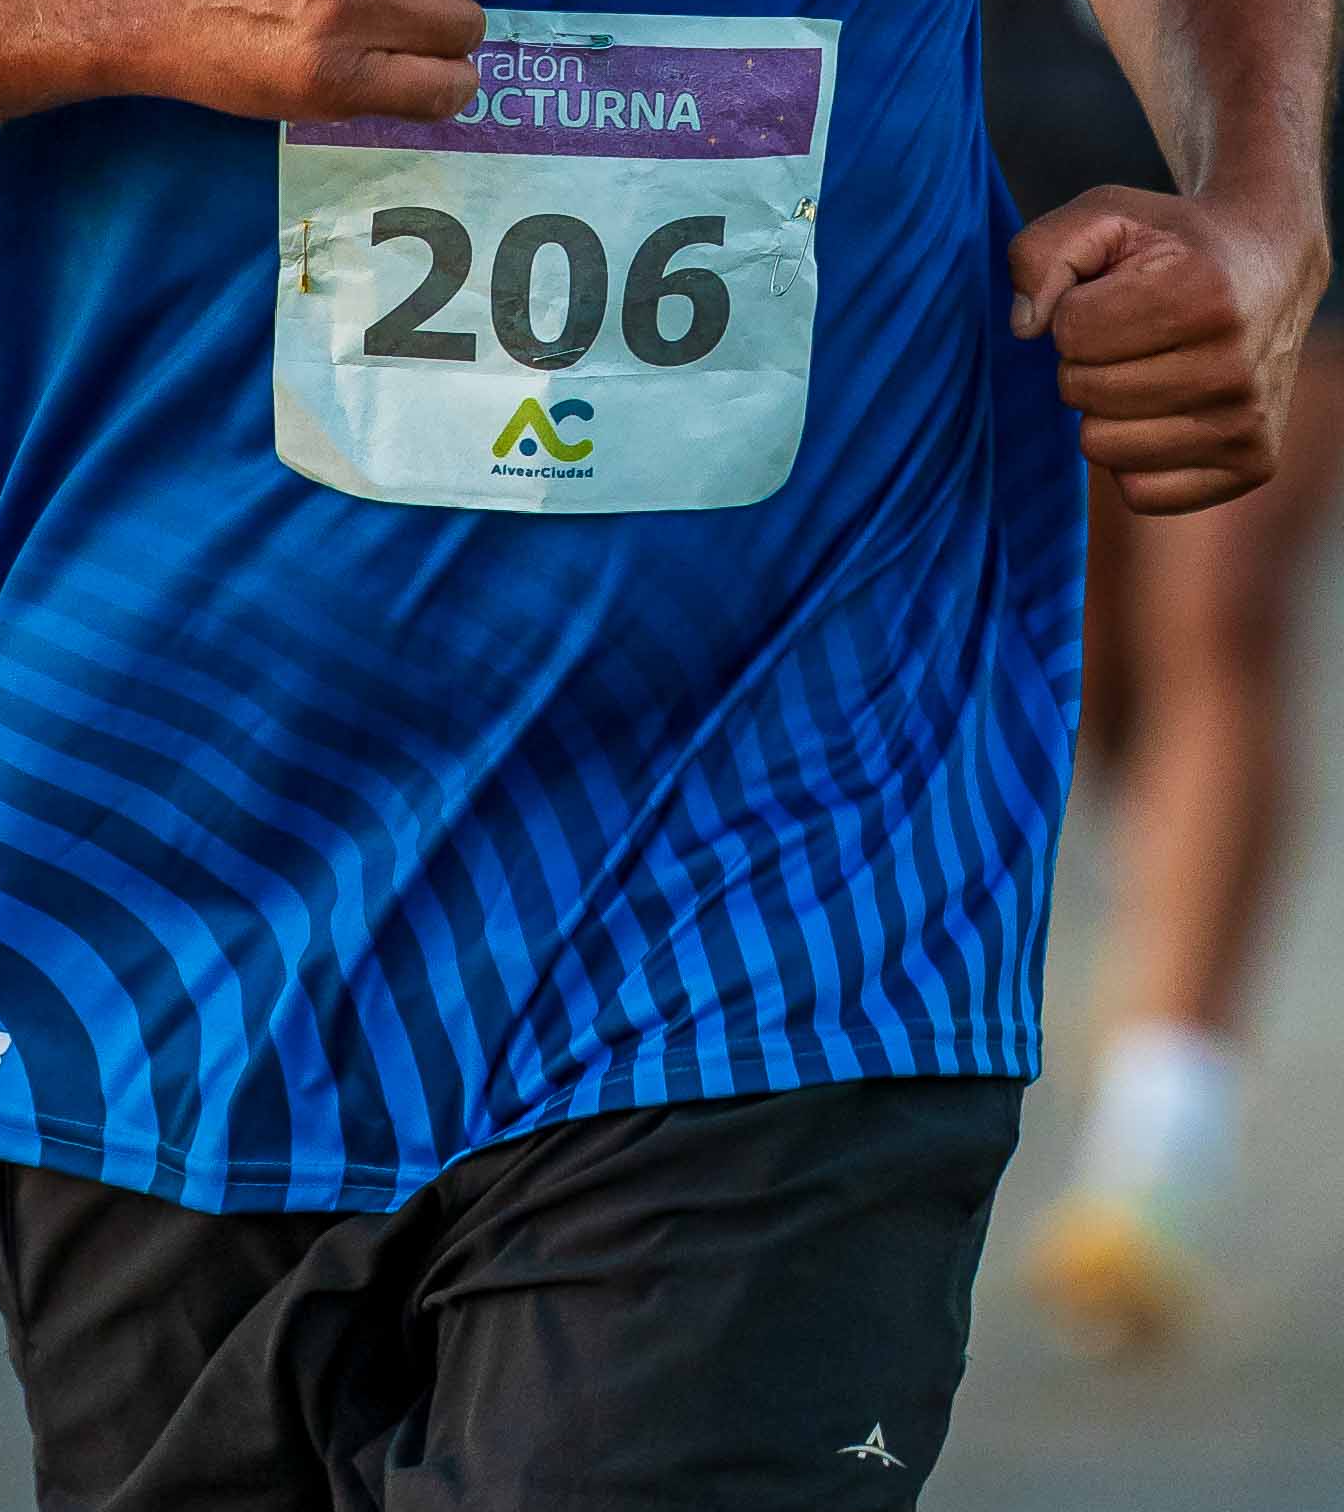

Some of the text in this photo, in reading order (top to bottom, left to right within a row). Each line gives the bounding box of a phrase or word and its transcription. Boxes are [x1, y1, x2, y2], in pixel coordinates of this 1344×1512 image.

[468, 47, 583, 83] ratón
[453, 86, 701, 131] OCTURNA
[363, 207, 730, 370] 206
[491, 464, 593, 478] AlvearCiudad
